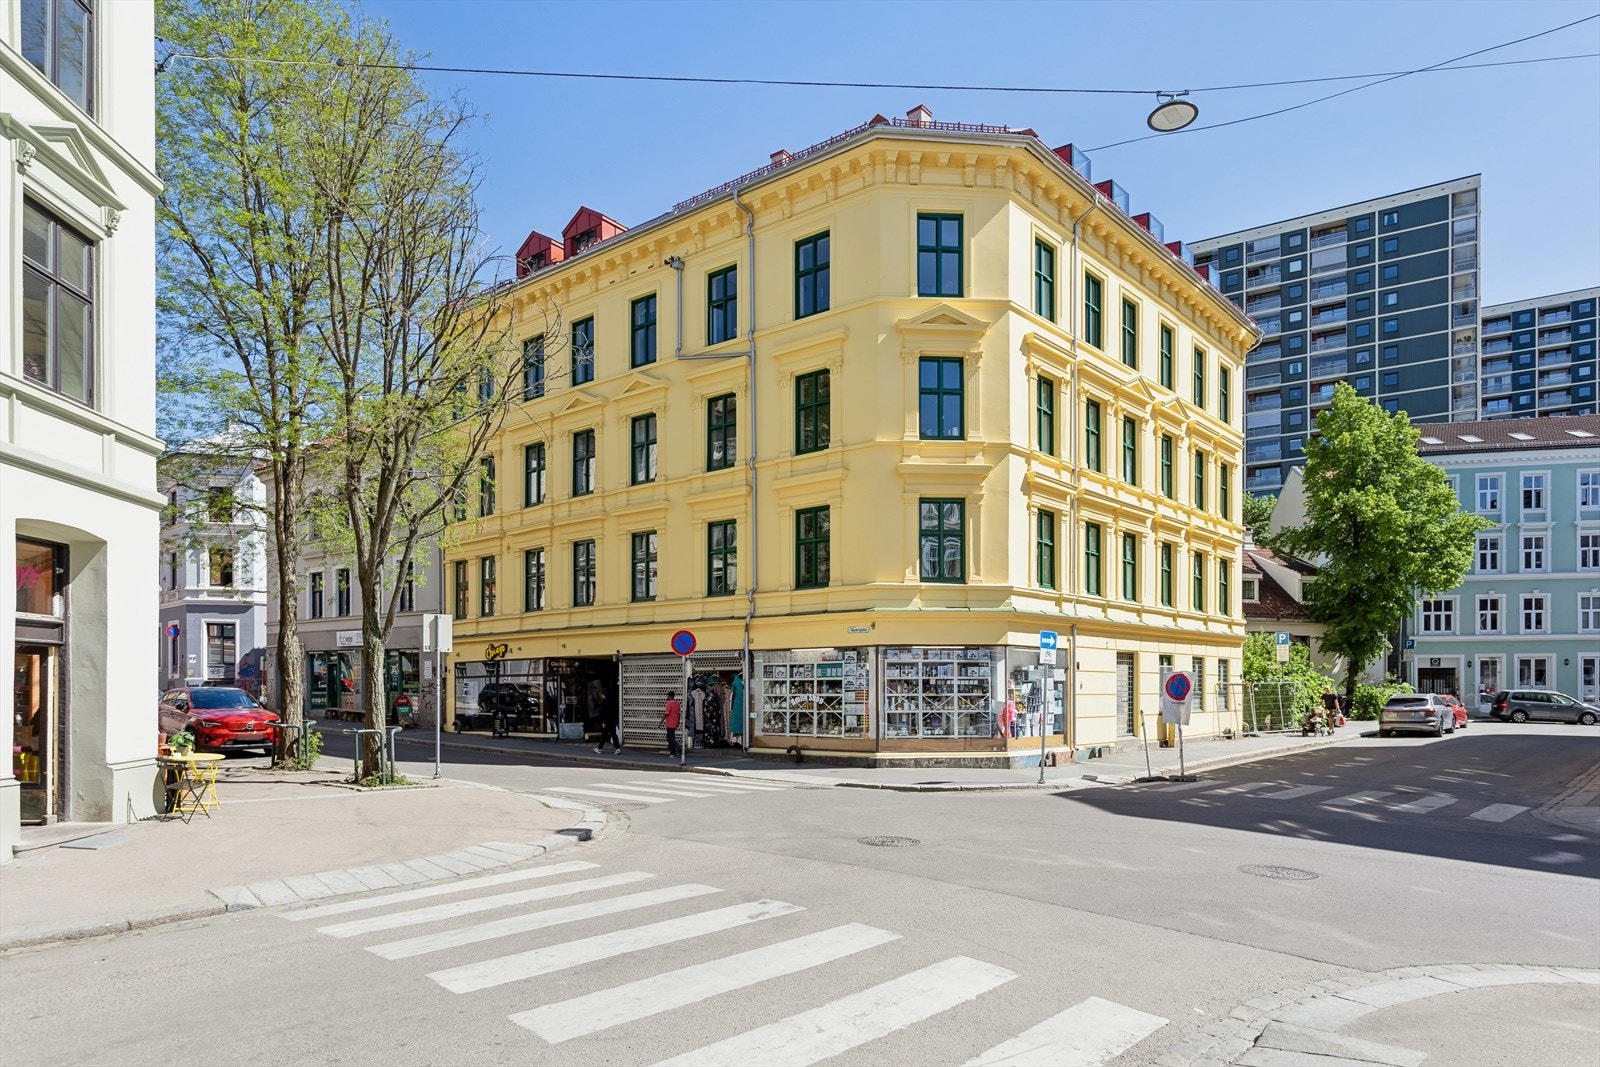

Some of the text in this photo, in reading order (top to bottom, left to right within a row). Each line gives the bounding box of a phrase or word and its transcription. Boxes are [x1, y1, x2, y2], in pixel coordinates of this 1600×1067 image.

[1278, 633, 1286, 644] P
[1406, 640, 1413, 648] P
[809, 693, 824, 704] Shop
